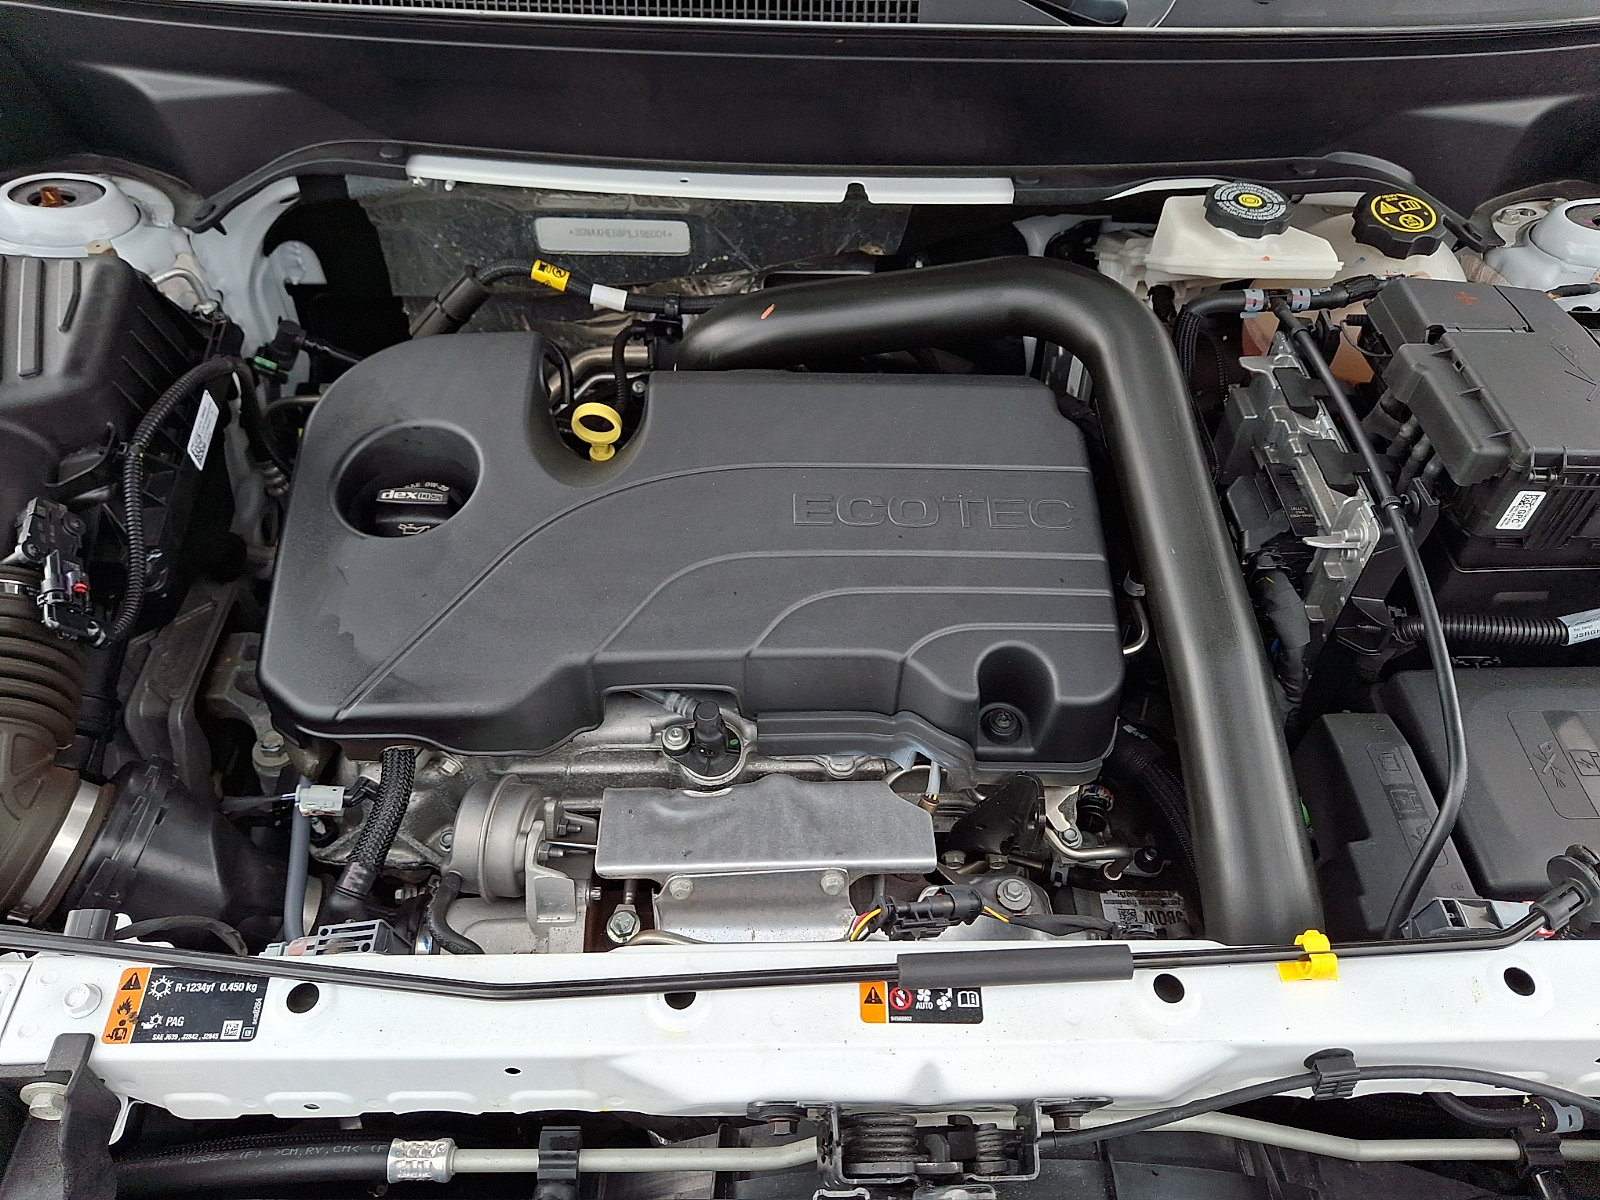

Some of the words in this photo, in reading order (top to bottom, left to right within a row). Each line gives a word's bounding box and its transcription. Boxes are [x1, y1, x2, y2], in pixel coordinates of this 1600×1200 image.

[792, 492, 1077, 530] ECOTEC
[1511, 509, 1527, 523] GPC
[175, 982, 216, 993] R-1234yf
[219, 982, 245, 992] 0.450
[245, 982, 257, 993] kg
[915, 1002, 934, 1010] AUTO
[165, 1016, 185, 1027] PAG
[152, 1033, 164, 1041] SAE
